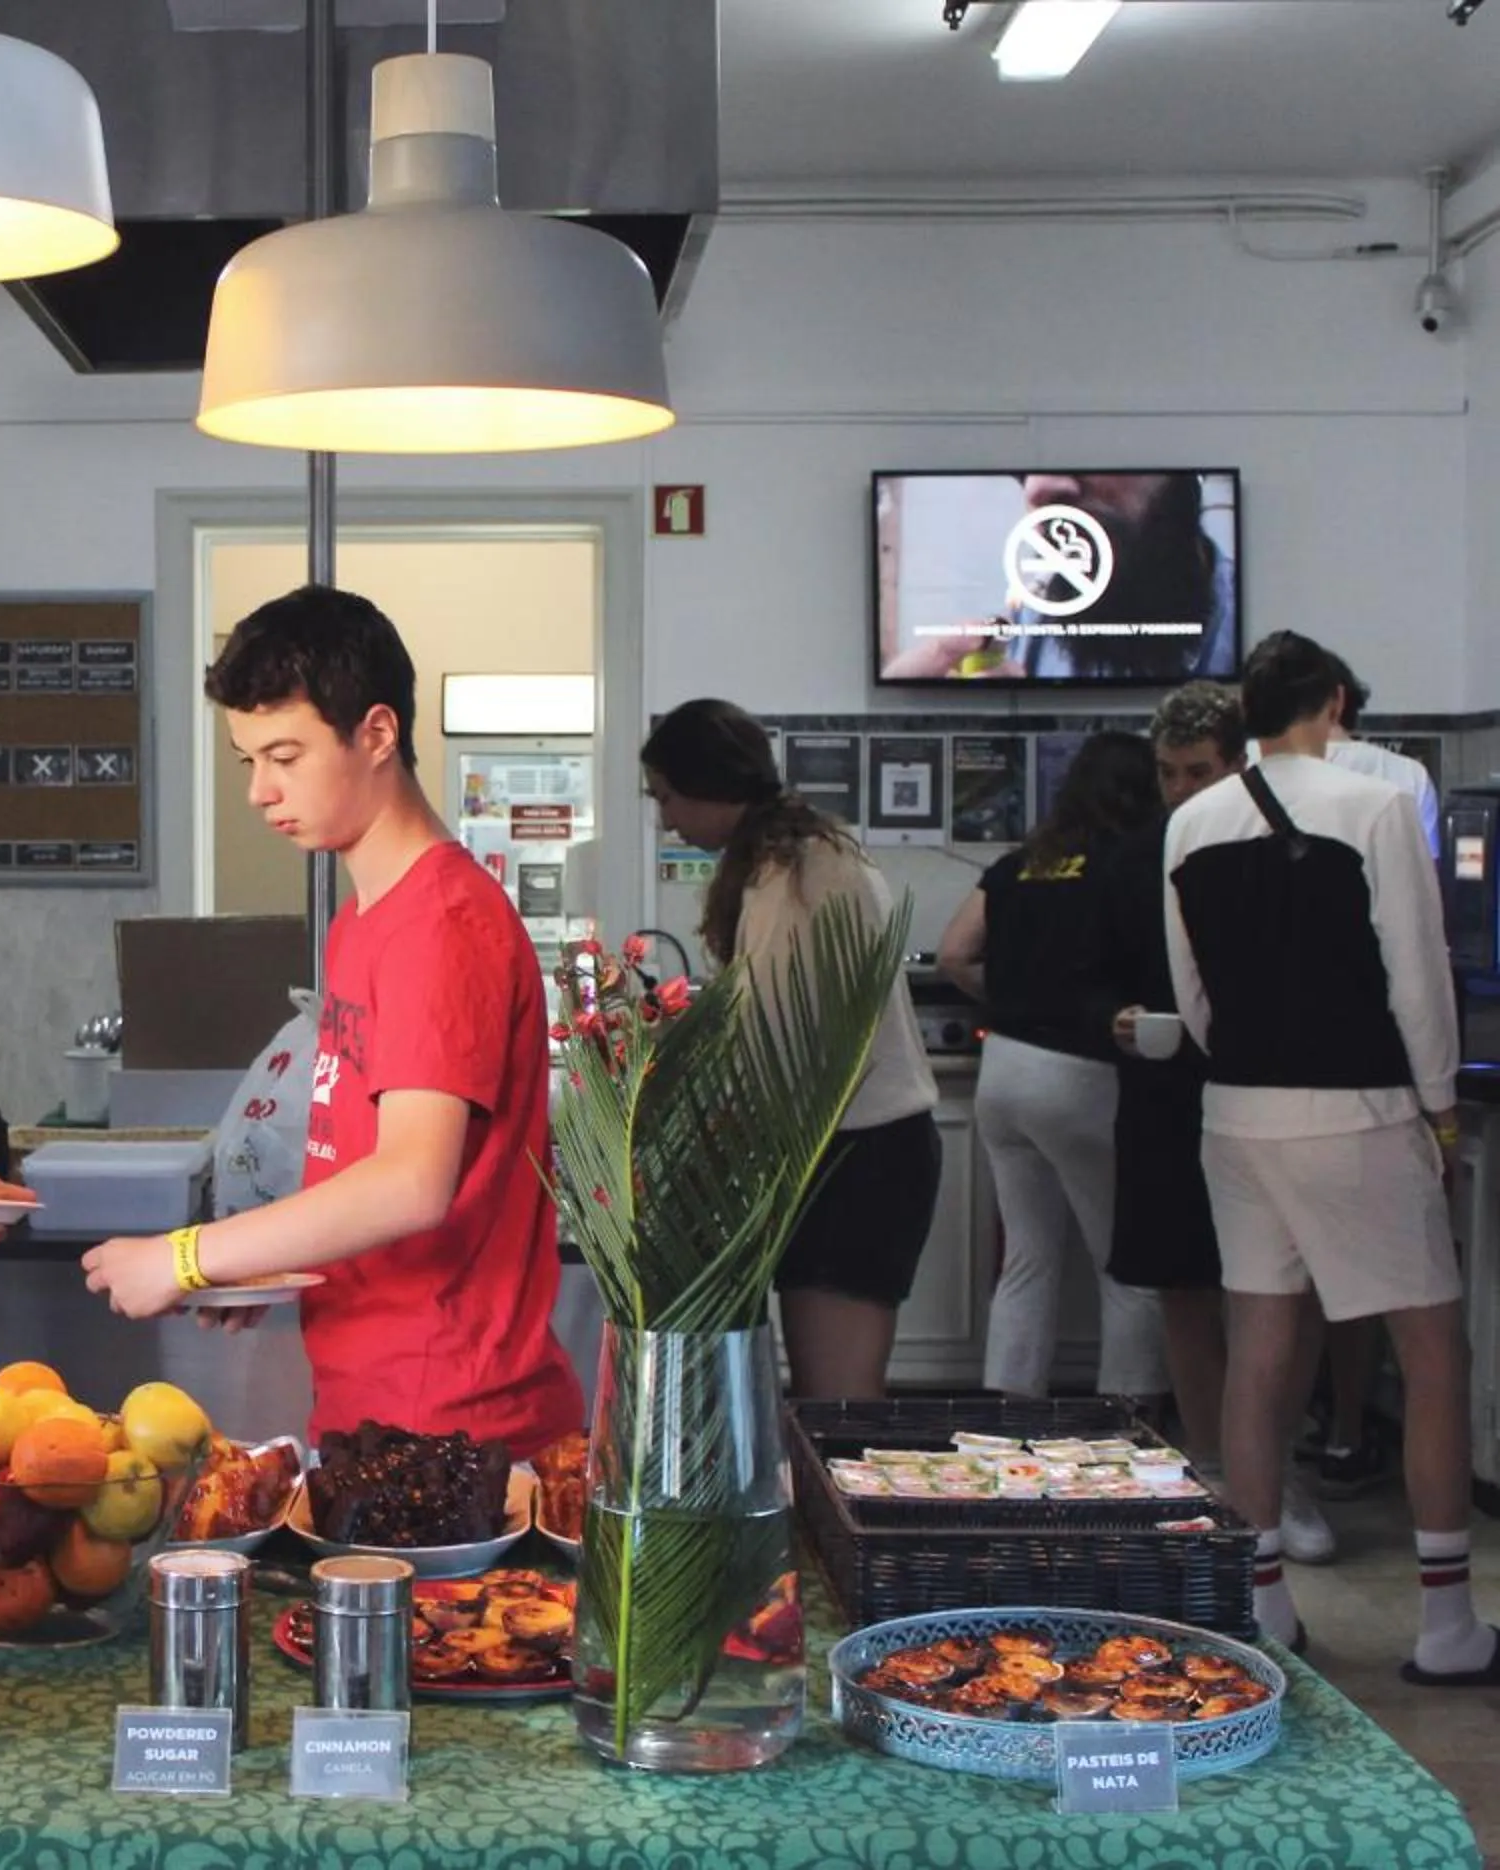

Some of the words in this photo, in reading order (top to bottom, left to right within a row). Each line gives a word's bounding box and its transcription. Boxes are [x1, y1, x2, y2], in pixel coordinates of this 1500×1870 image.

[127, 1727, 218, 1741] POWDERED
[305, 1740, 391, 1753] CINNAMON
[144, 1747, 199, 1761] SUGAR
[1137, 1751, 1160, 1766] DE
[1092, 1774, 1139, 1790] NATA
